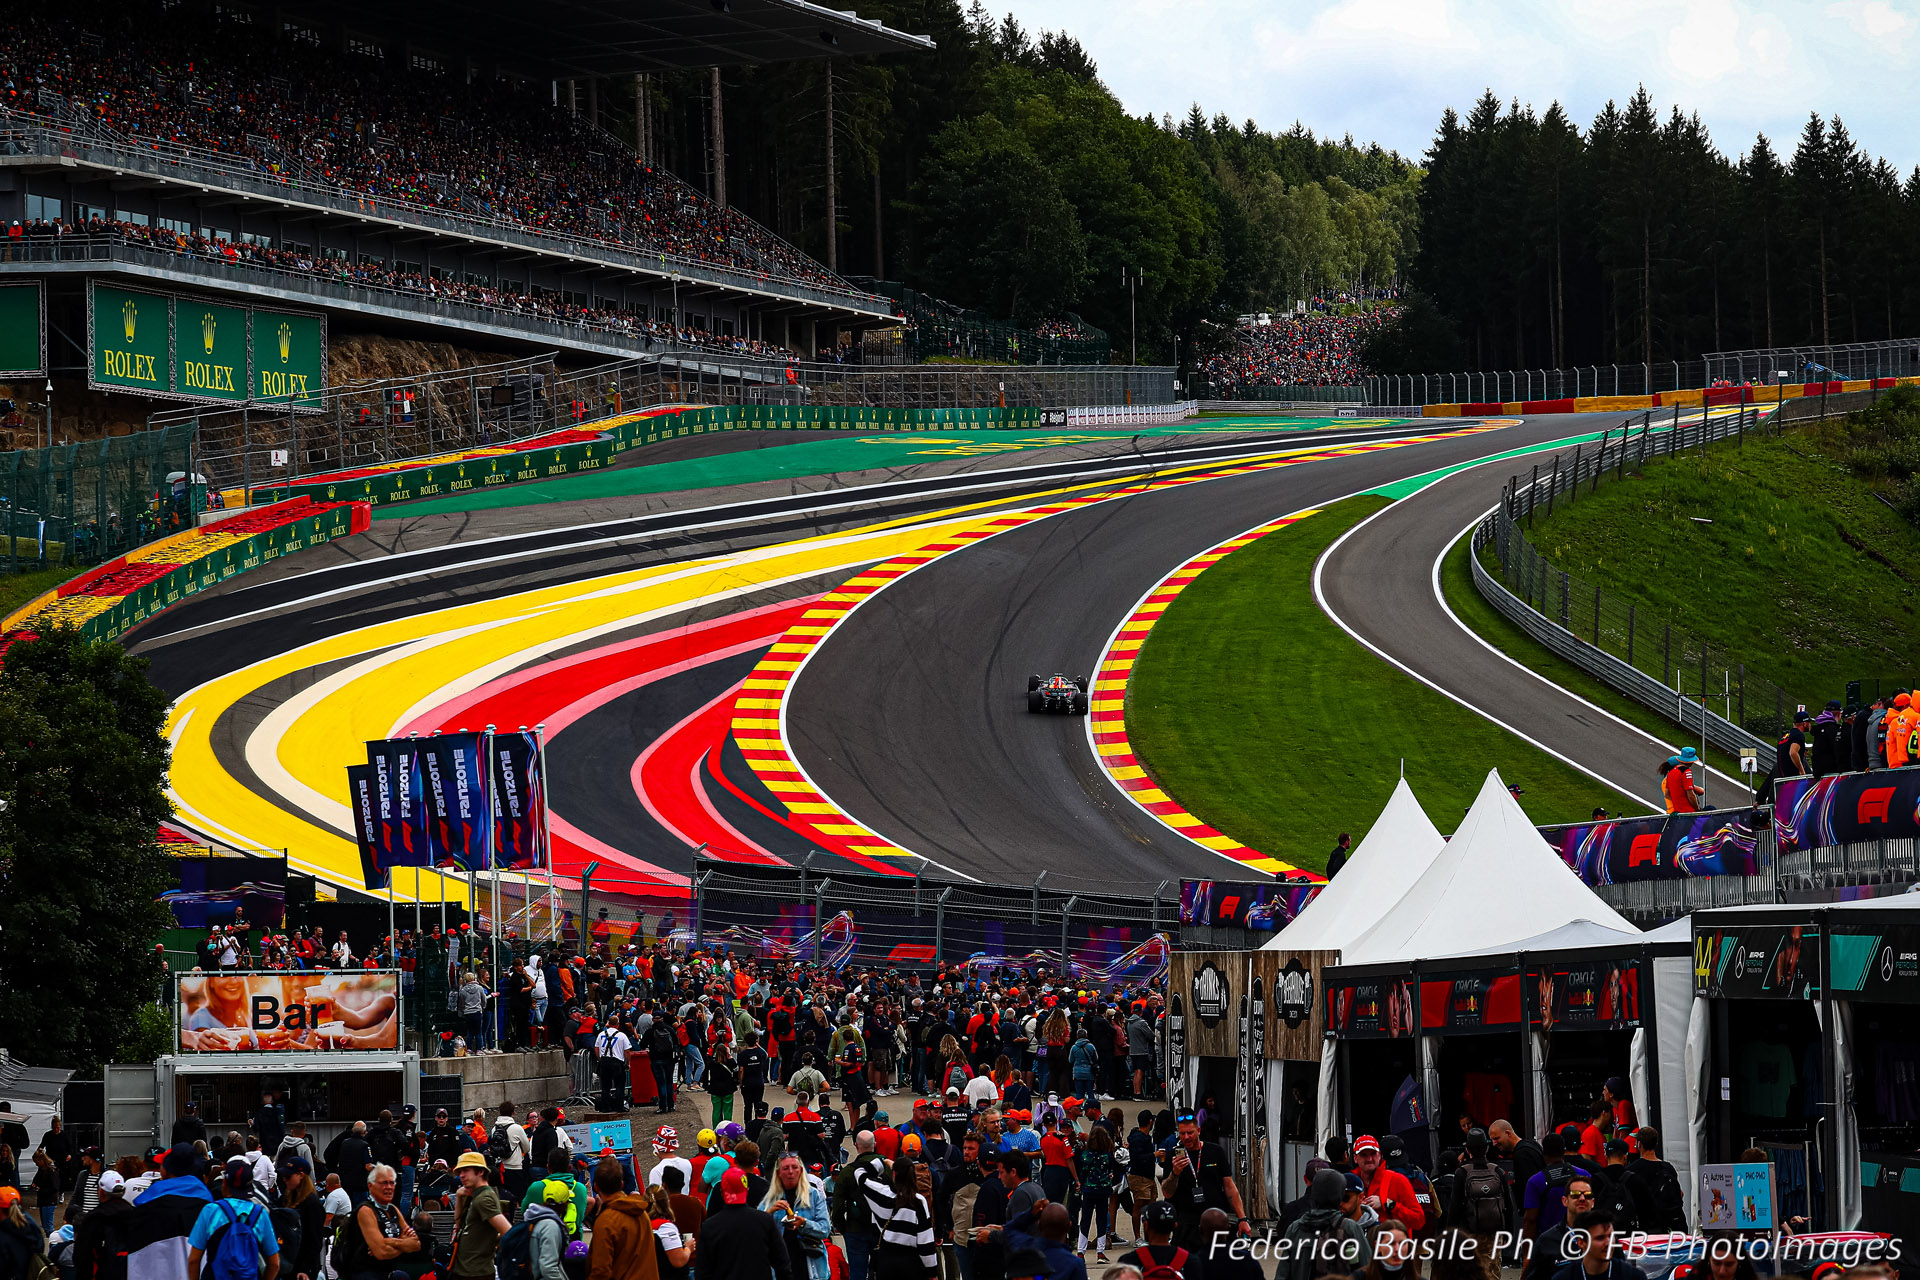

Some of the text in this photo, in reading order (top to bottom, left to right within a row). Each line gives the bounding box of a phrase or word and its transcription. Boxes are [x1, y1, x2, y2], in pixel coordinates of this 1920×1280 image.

[104, 349, 157, 381] ROLEX
[184, 360, 235, 392] ROLEX
[261, 370, 309, 399] ROLEX
[484, 473, 506, 485] ROLEX
[517, 468, 538, 480] ROLEX
[420, 484, 439, 496] ROLEX
[451, 479, 473, 491] ROLEX
[390, 489, 411, 501] ROLEX
[331, 525, 346, 537] ROLEX
[285, 539, 302, 553] ROLEX
[310, 533, 326, 546] ROLEX
[376, 755, 391, 819] FANZONE
[399, 754, 412, 818] FANZONE
[426, 752, 447, 817] FANZONE
[453, 749, 472, 819] FANZONE
[500, 750, 521, 818] FANZONE
[359, 779, 376, 843] FANZONE
[1568, 971, 1595, 985] ORACLE
[1356, 985, 1378, 998] ORACLE
[1455, 979, 1480, 993] ORACLE
[252, 995, 326, 1030] Bar
